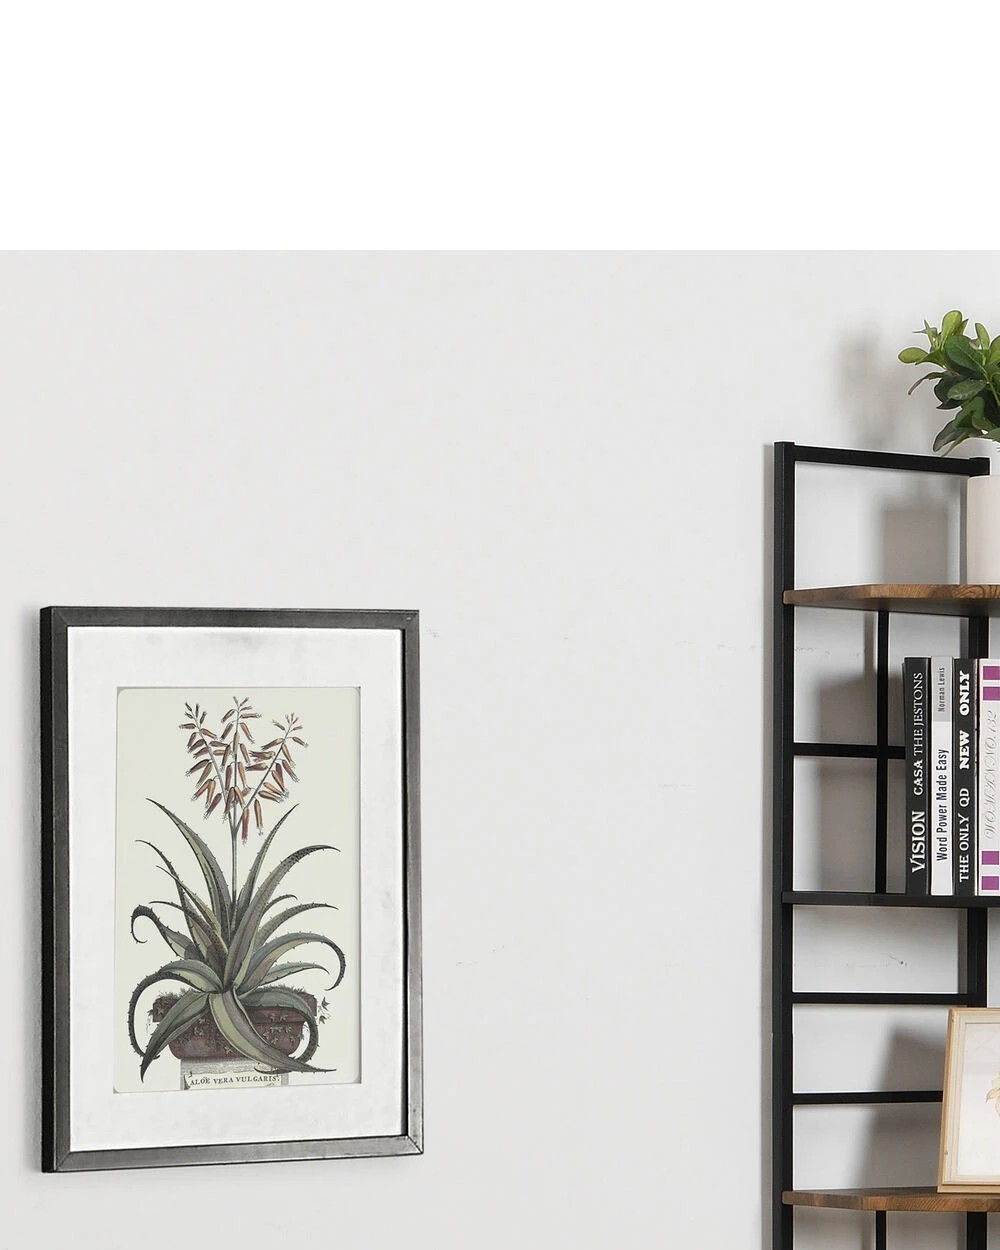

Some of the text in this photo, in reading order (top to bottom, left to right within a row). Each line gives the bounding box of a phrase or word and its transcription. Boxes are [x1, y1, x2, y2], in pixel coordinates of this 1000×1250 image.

[937, 667, 945, 712] Norman Lewis
[910, 673, 925, 872] VISION CASA THE JESTONS
[935, 749, 949, 861] Word Power Made Easy
[958, 671, 970, 882] THE ONLY QD NEW ONLY
